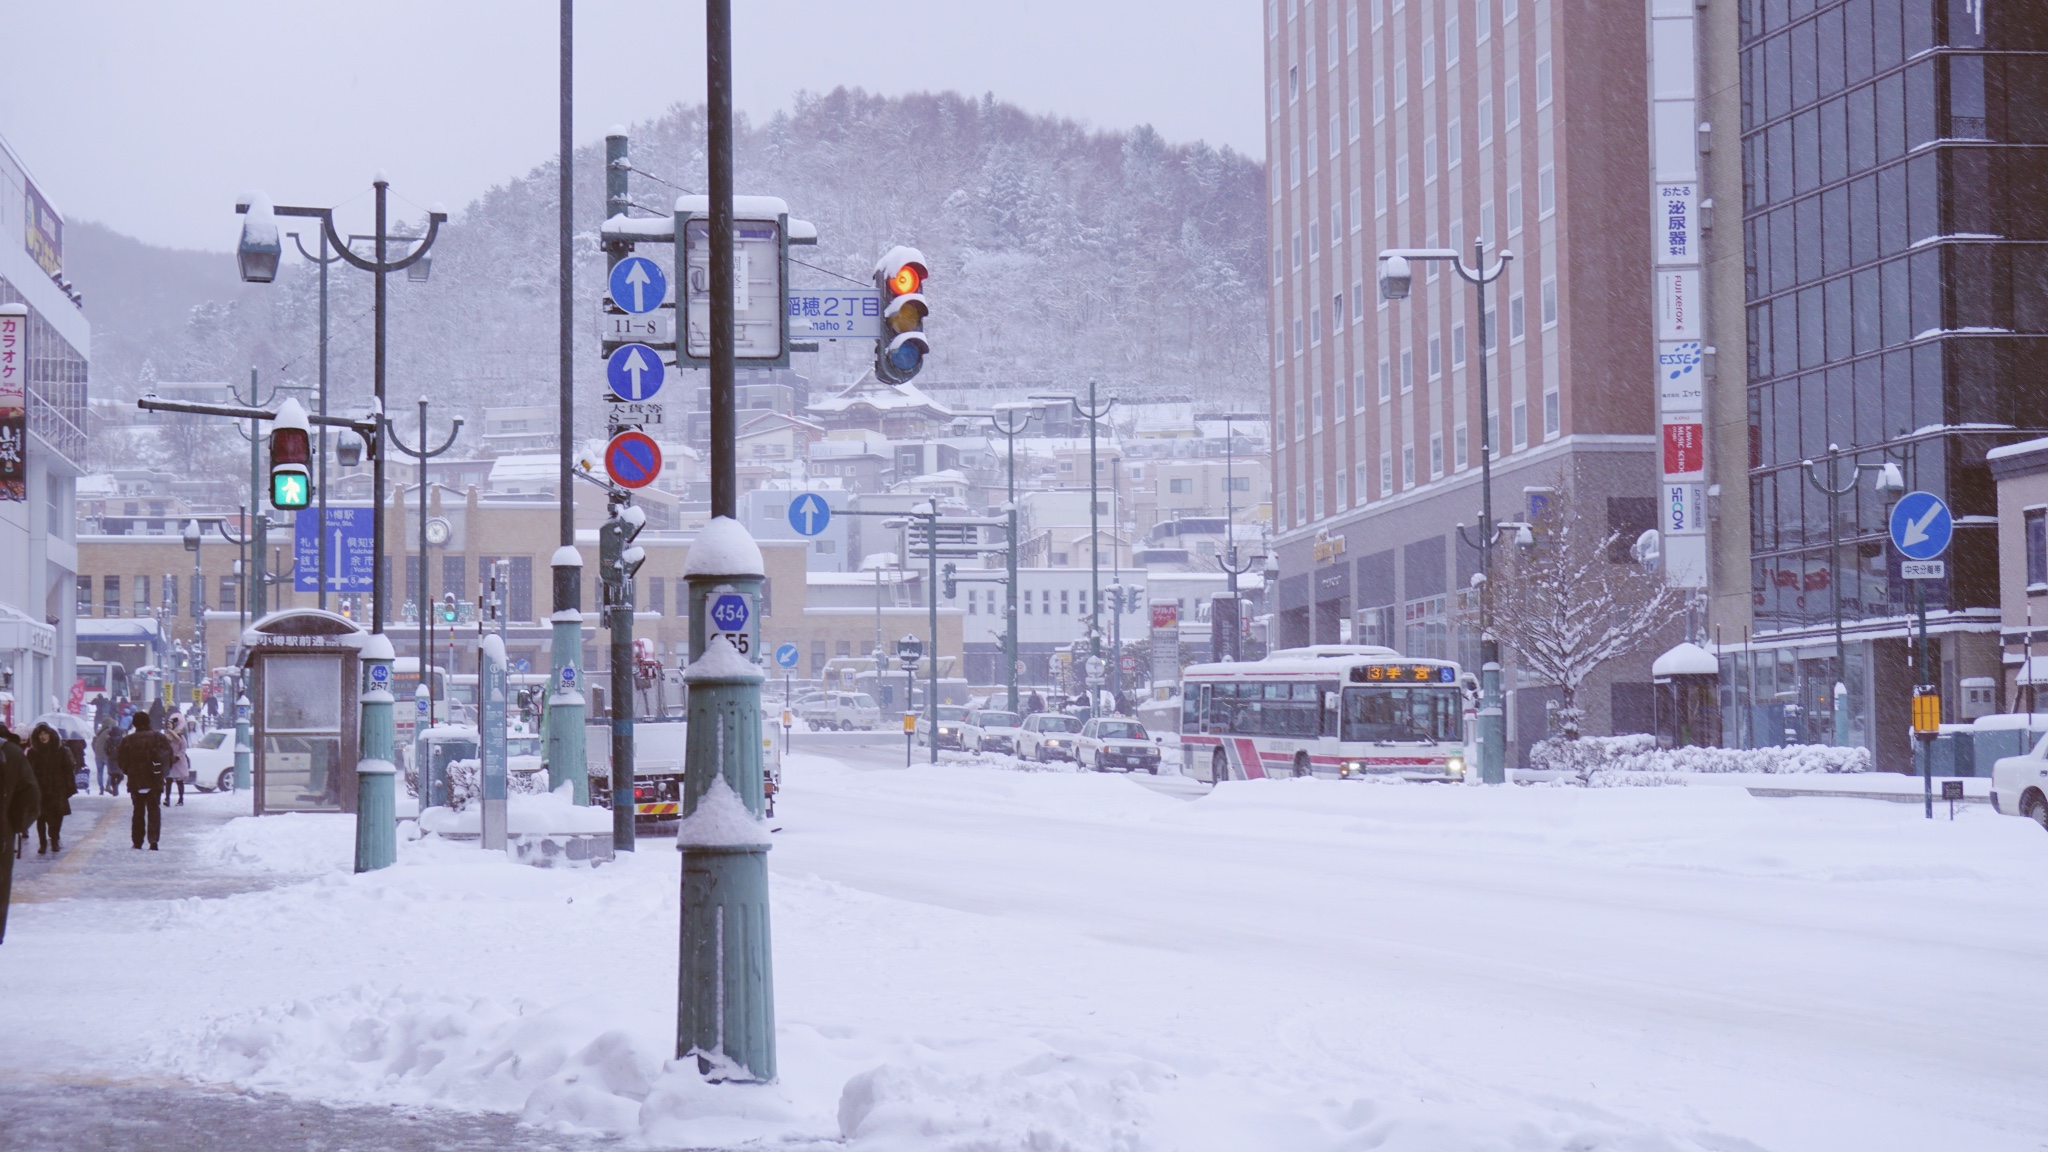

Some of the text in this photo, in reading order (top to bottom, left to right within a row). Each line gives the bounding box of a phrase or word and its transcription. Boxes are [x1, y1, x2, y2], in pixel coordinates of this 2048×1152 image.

[1662, 186, 1691, 196] おたる
[1668, 200, 1687, 256] 泌尿器科
[1674, 275, 1682, 293] FUJI
[808, 319, 854, 331] naho 2
[2, 319, 17, 379] カラオケ
[1660, 354, 1692, 365] ESSE
[1677, 425, 1685, 449] MUSIC
[1685, 425, 1693, 448] KAWAI
[1671, 487, 1685, 530] SECOM
[714, 604, 745, 622] 454
[710, 632, 749, 655] 55
[373, 669, 387, 678] 454
[370, 681, 388, 691] 257
[561, 680, 576, 688] 259
